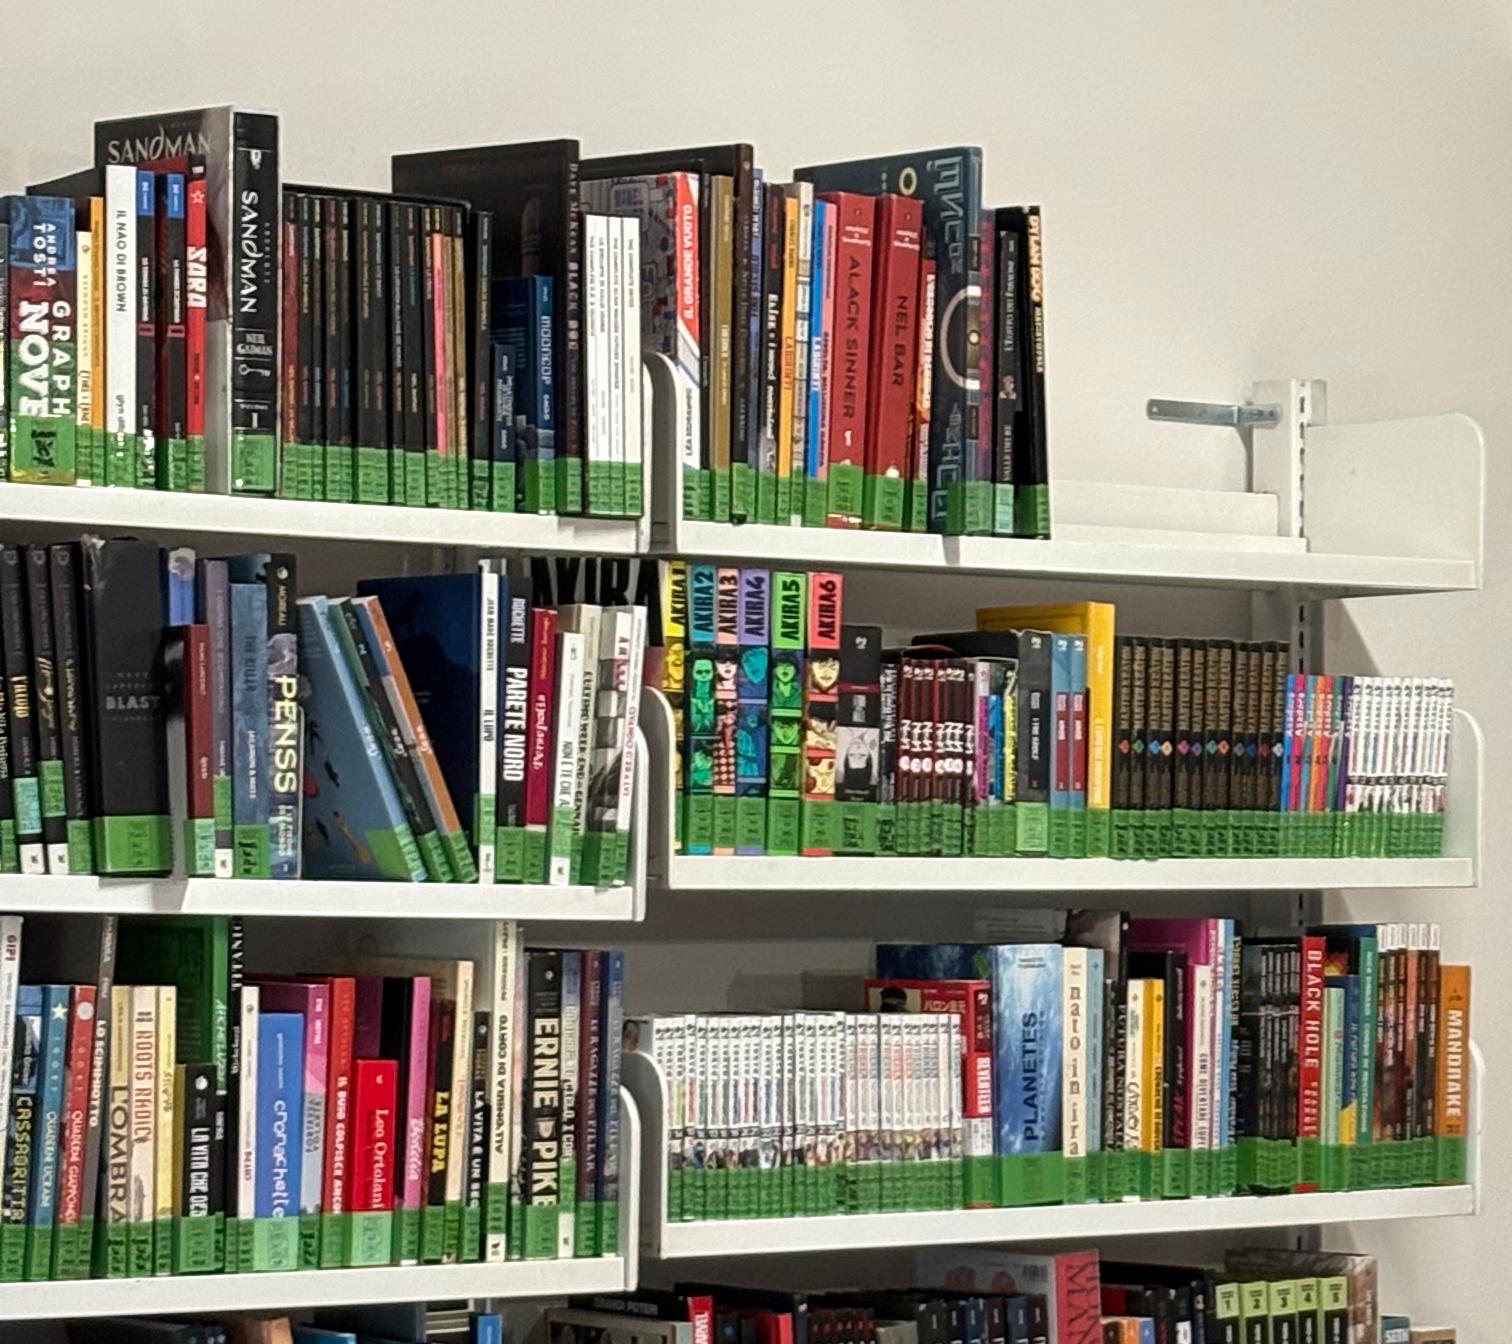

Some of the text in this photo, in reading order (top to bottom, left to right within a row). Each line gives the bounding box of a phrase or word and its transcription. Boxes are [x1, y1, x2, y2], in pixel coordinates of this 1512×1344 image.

[108, 140, 211, 162] SANDMAN
[33, 223, 46, 286] TOSTI
[46, 223, 56, 287] ANDREA
[115, 210, 127, 312] IL NAO DI BROWN
[186, 246, 207, 307] SARA
[240, 190, 263, 313] SANDMAN
[684, 205, 693, 319] IL GRANDE VUOTO
[1028, 215, 1043, 302] DYLAN DOG
[19, 301, 50, 417] NOVE
[51, 301, 72, 418] GRAPH
[811, 336, 821, 391] LABIRINTI
[843, 258, 861, 418] ALACK SINNER
[892, 296, 908, 387] NEL BAR
[695, 587, 713, 632] AKIRA
[719, 590, 737, 634] AKIRA
[745, 589, 764, 636] AKIRA
[782, 592, 799, 640] AKIRA
[820, 592, 836, 640] AKIRA
[105, 696, 159, 709] BLAST
[503, 598, 527, 781] ROCHETTE PARETE NORD
[273, 676, 296, 793] PENSS
[561, 741, 573, 759] NON
[559, 783, 571, 798] CHE
[5, 935, 16, 962] GIPI
[498, 1014, 507, 1059] CORTO
[1304, 950, 1322, 1068] BLACK HOLE
[474, 1091, 484, 1107] LA
[1021, 1012, 1038, 1141] PLANETES
[1116, 1004, 1127, 1151] FUTURA NOSTALG
[1446, 1009, 1462, 1117] MANDRAKE
[110, 1085, 129, 1223] L'OMBRA
[332, 1077, 348, 1214] IL BUIO COLPISCE ANCOR
[431, 1091, 449, 1174] LA LUPA
[473, 1112, 483, 1142] VITA
[531, 1018, 559, 1206] ERNIE PIKE
[190, 1128, 210, 1217] LA VITA CHE DES
[271, 1100, 288, 1218] cronachette
[371, 1109, 388, 1209] Leo Ortolani
[470, 1159, 481, 1179] UN
[470, 1183, 480, 1208] SEG
